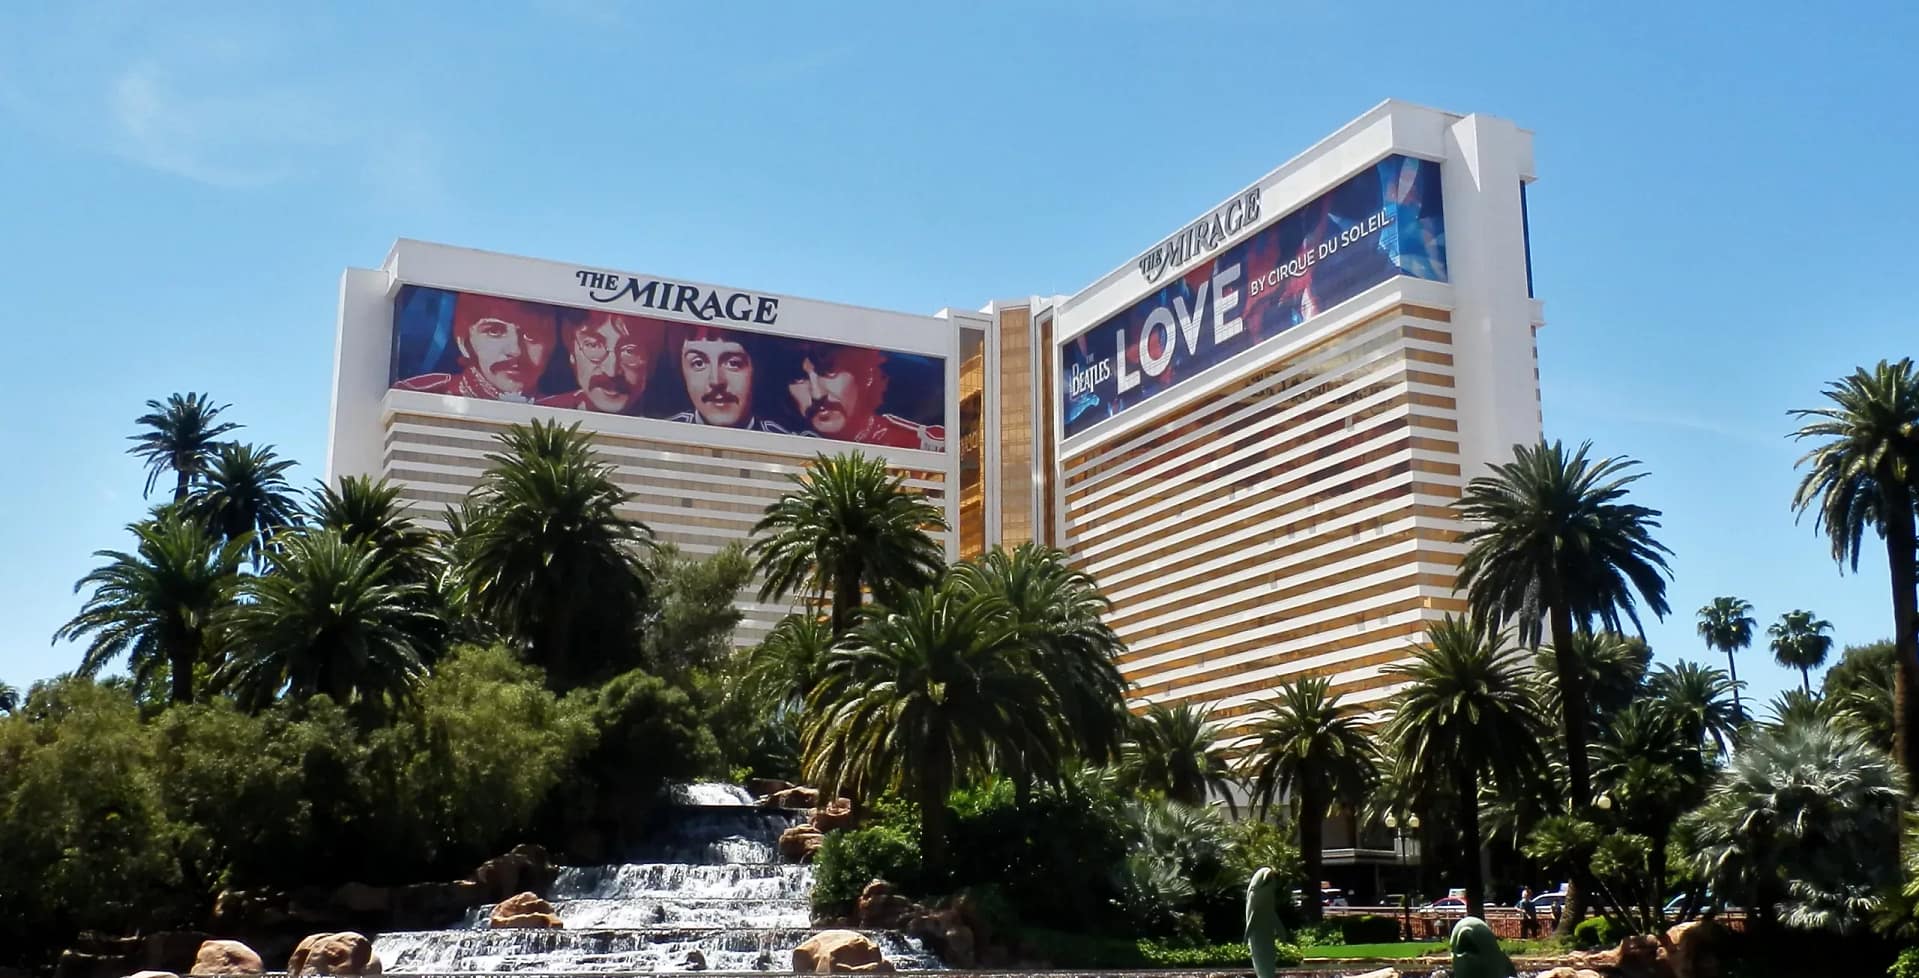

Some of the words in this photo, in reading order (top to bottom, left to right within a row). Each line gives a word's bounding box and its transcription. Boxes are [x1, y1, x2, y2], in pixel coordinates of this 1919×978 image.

[1139, 247, 1163, 275] THE
[1147, 187, 1260, 284] MIRAGE
[575, 270, 620, 291] THE
[1250, 275, 1266, 296] BY
[1268, 249, 1316, 286] CIRQUE
[1319, 236, 1338, 260] DU
[589, 277, 780, 325] MIRAGE
[1116, 262, 1243, 395] LOVE
